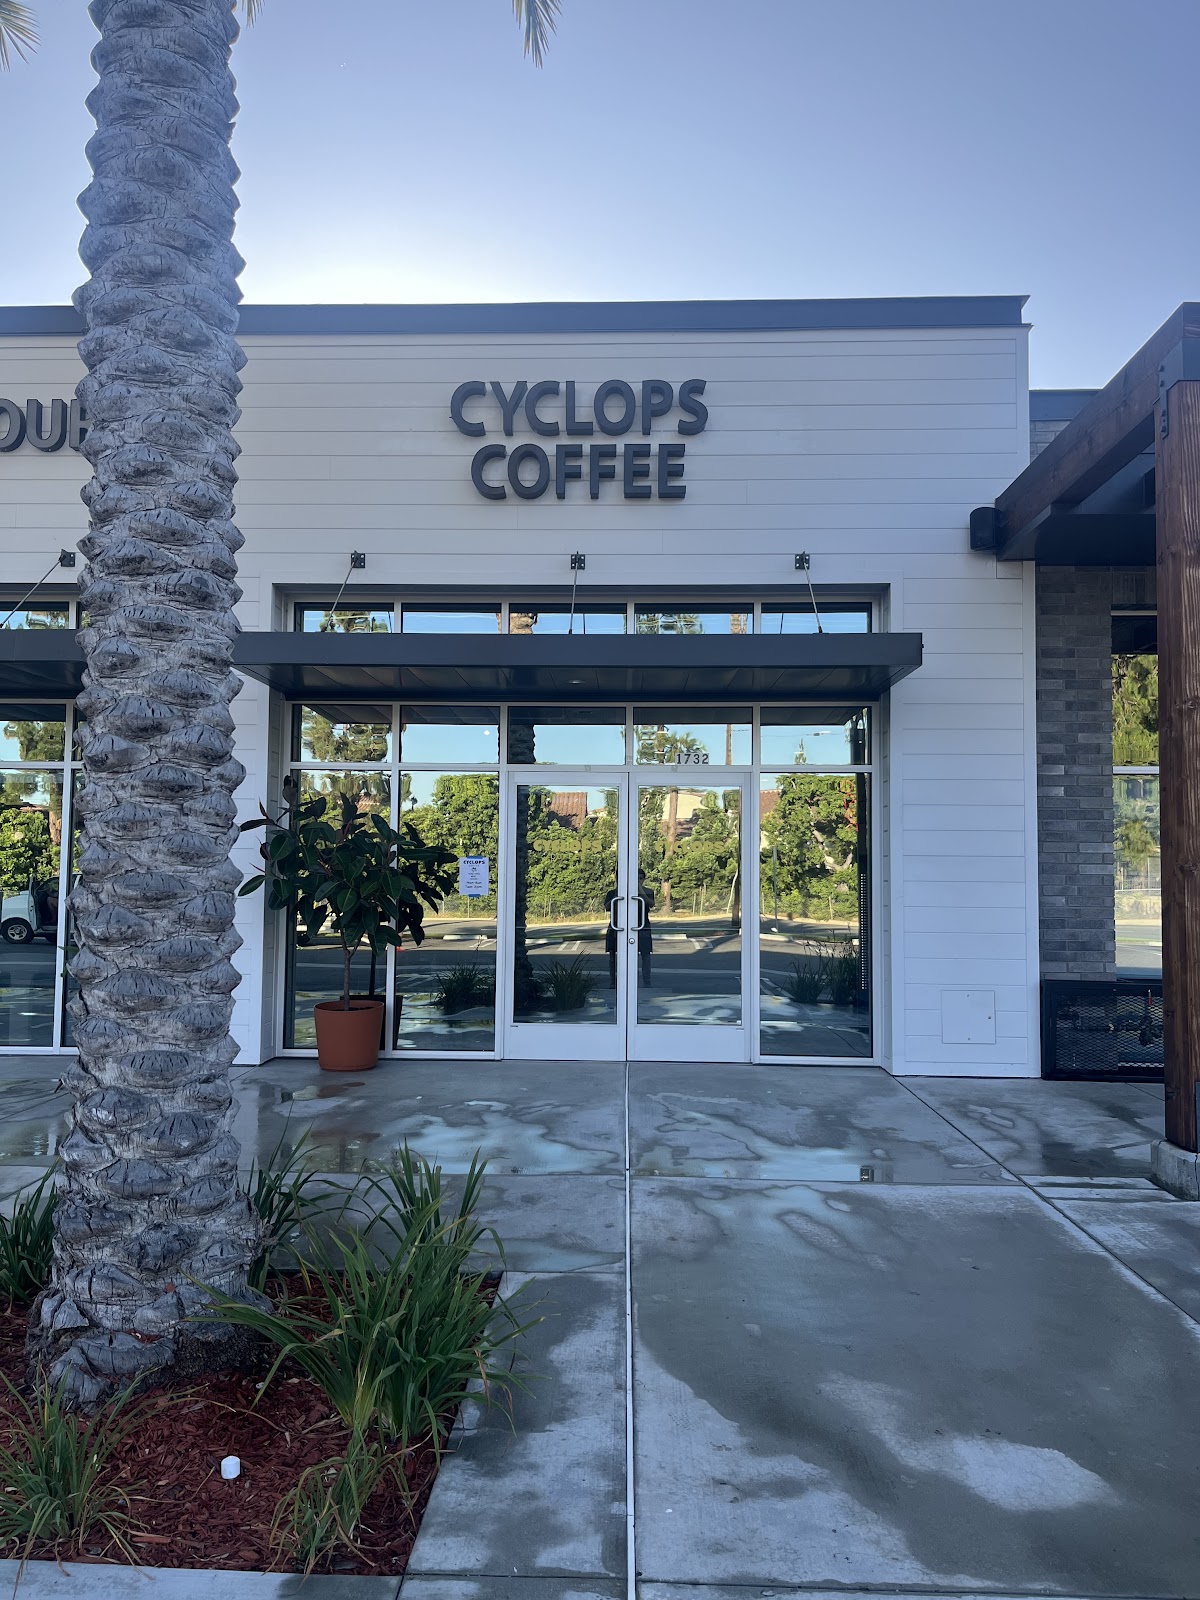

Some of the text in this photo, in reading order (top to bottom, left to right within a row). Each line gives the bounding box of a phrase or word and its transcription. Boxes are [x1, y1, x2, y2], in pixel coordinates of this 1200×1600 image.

[450, 378, 709, 437] CYCLOPS
[470, 443, 687, 500] COFFEE
[676, 753, 709, 765] 1732
[533, 840, 603, 852] CYCLOPS
[654, 840, 725, 853] CYCLOPS
